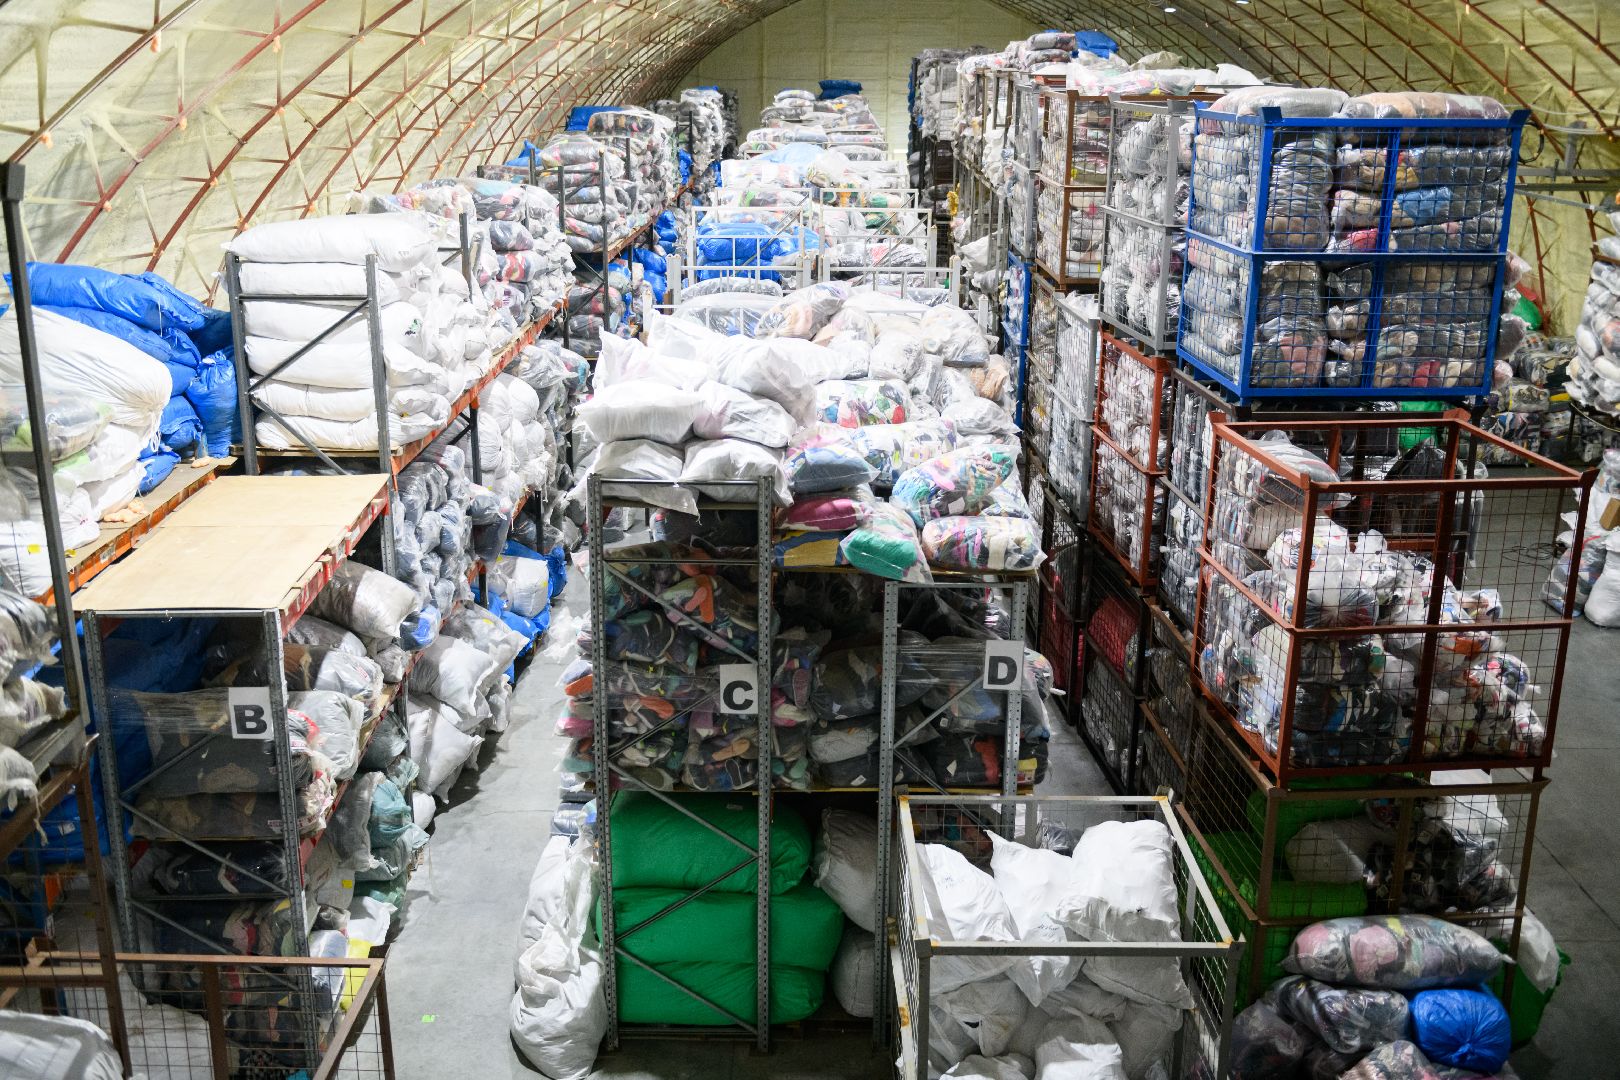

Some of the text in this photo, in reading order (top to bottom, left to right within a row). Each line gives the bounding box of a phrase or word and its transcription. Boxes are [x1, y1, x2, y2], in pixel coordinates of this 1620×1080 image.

[988, 656, 1017, 685] D
[723, 680, 753, 710] C
[234, 705, 267, 734] B
